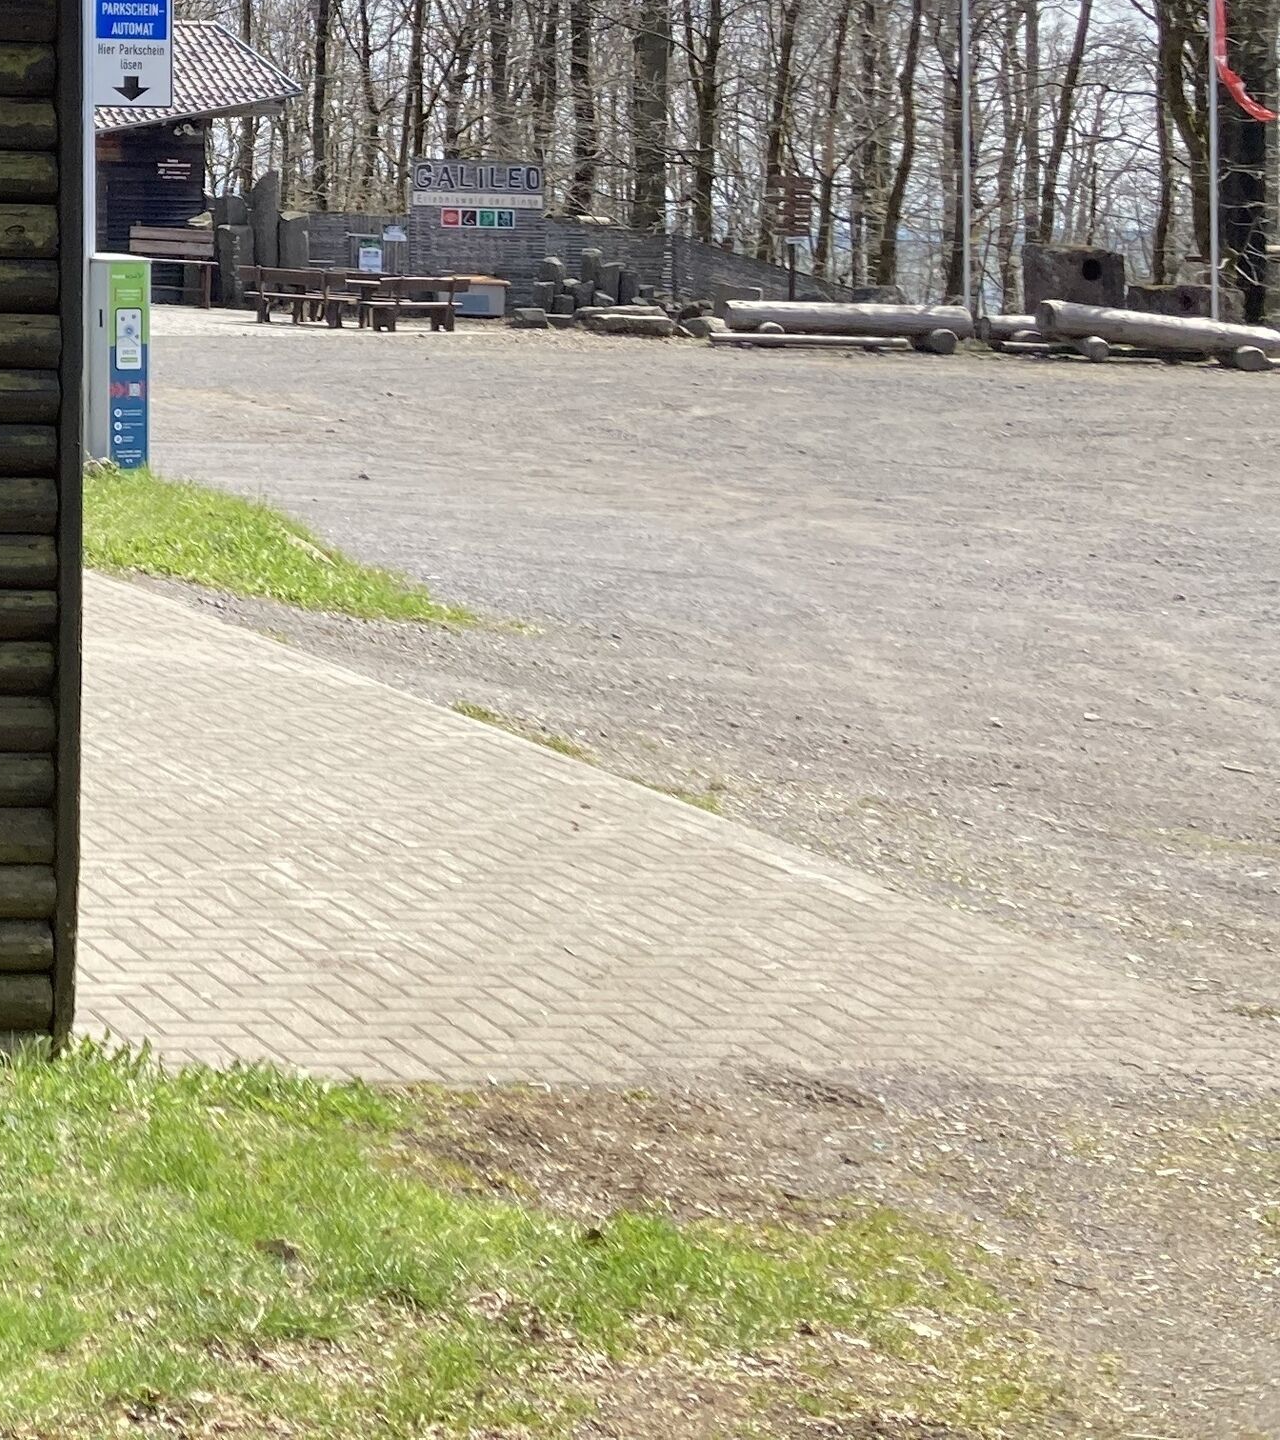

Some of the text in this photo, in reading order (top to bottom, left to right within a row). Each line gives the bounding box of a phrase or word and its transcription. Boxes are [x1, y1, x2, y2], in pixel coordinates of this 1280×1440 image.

[101, 2, 165, 16] PARKSCHEIN-
[111, 22, 155, 36] AUTOMAT
[97, 43, 165, 56] Hier Parkschein
[120, 58, 143, 70] lösen
[415, 163, 541, 191] GALILEO
